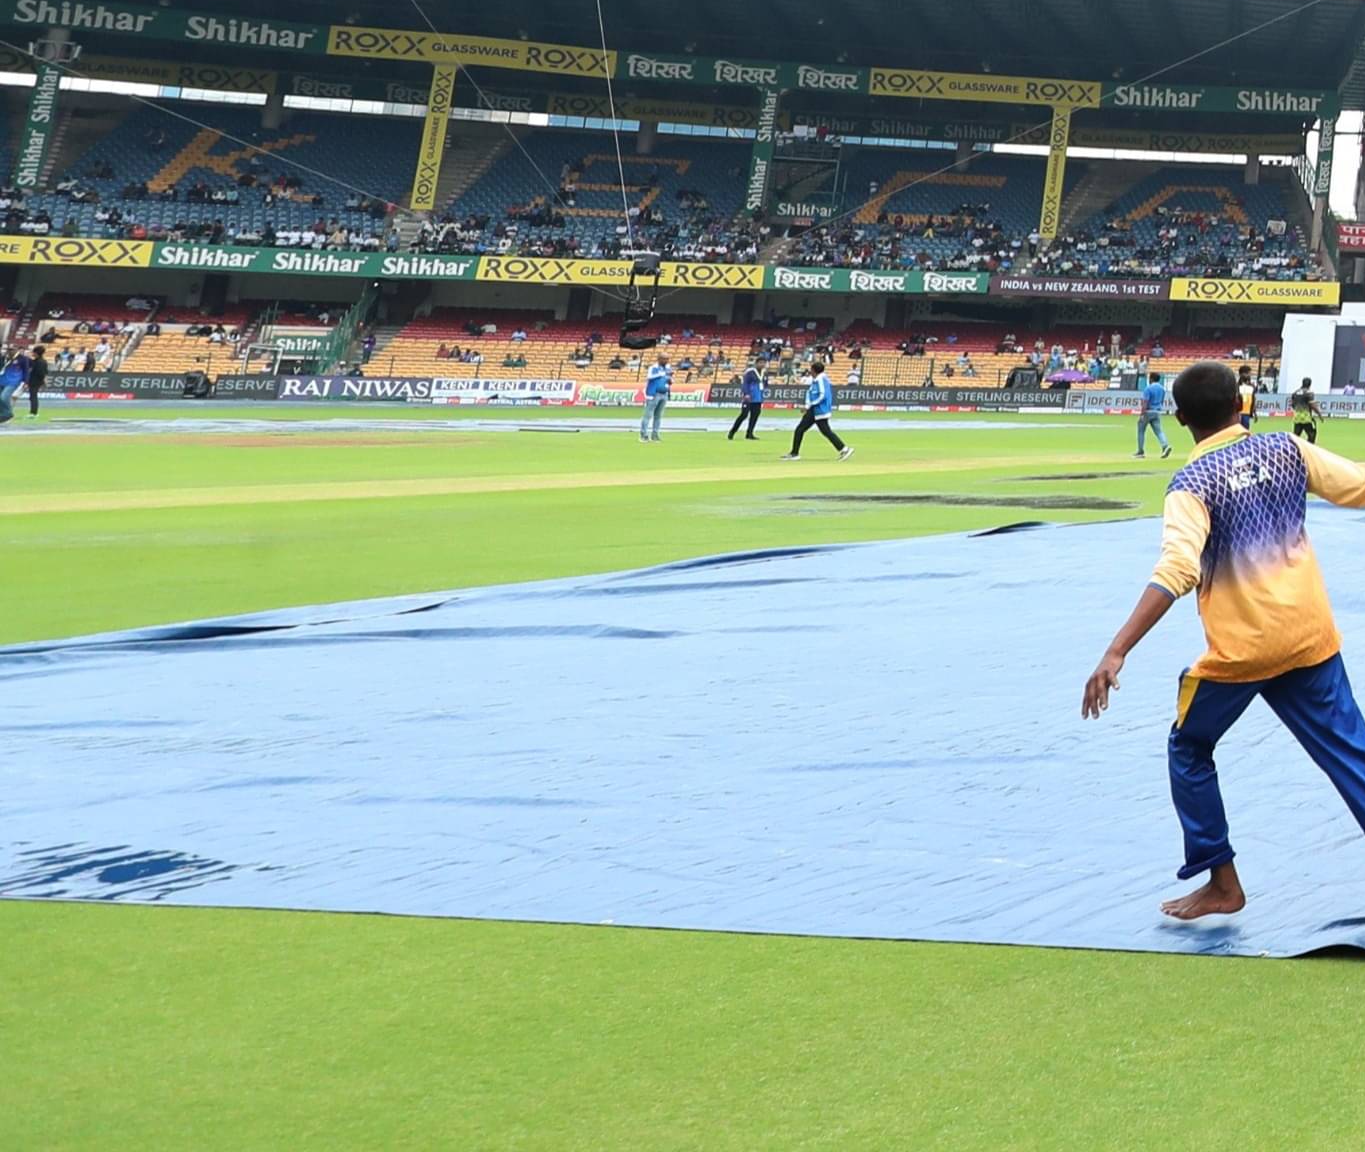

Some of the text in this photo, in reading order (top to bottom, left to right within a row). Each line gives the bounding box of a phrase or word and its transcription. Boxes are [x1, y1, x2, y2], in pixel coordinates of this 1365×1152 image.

[186, 15, 313, 50] Shikhar
[334, 30, 610, 76] ROXX GLASSWARE ROXX
[628, 54, 858, 90] शिखर शिखर शिखर
[873, 73, 1094, 103] ROXX GLASSWARE ROXX
[1115, 86, 1321, 113] Shikhar Shikhar
[18, 66, 59, 186] Shikhar Shikhar
[747, 90, 777, 210] Shikhar Shikhar
[29, 239, 143, 264] ROXX
[158, 246, 471, 276] Shikhar Shikhar Shikhar
[483, 258, 755, 287] ROXX ROXX
[775, 267, 978, 291] शिखर शिखर शिखर
[1000, 279, 1161, 294] INDIA vs NEW ZEALAND, 1st TEST
[1187, 281, 1323, 299] ROXX GLASSWARE
[283, 380, 429, 397] RAJ NIWAS
[837, 390, 1063, 403] STERLING RESERVE STERLING RESERVE
[1087, 394, 1112, 406] IDFC
